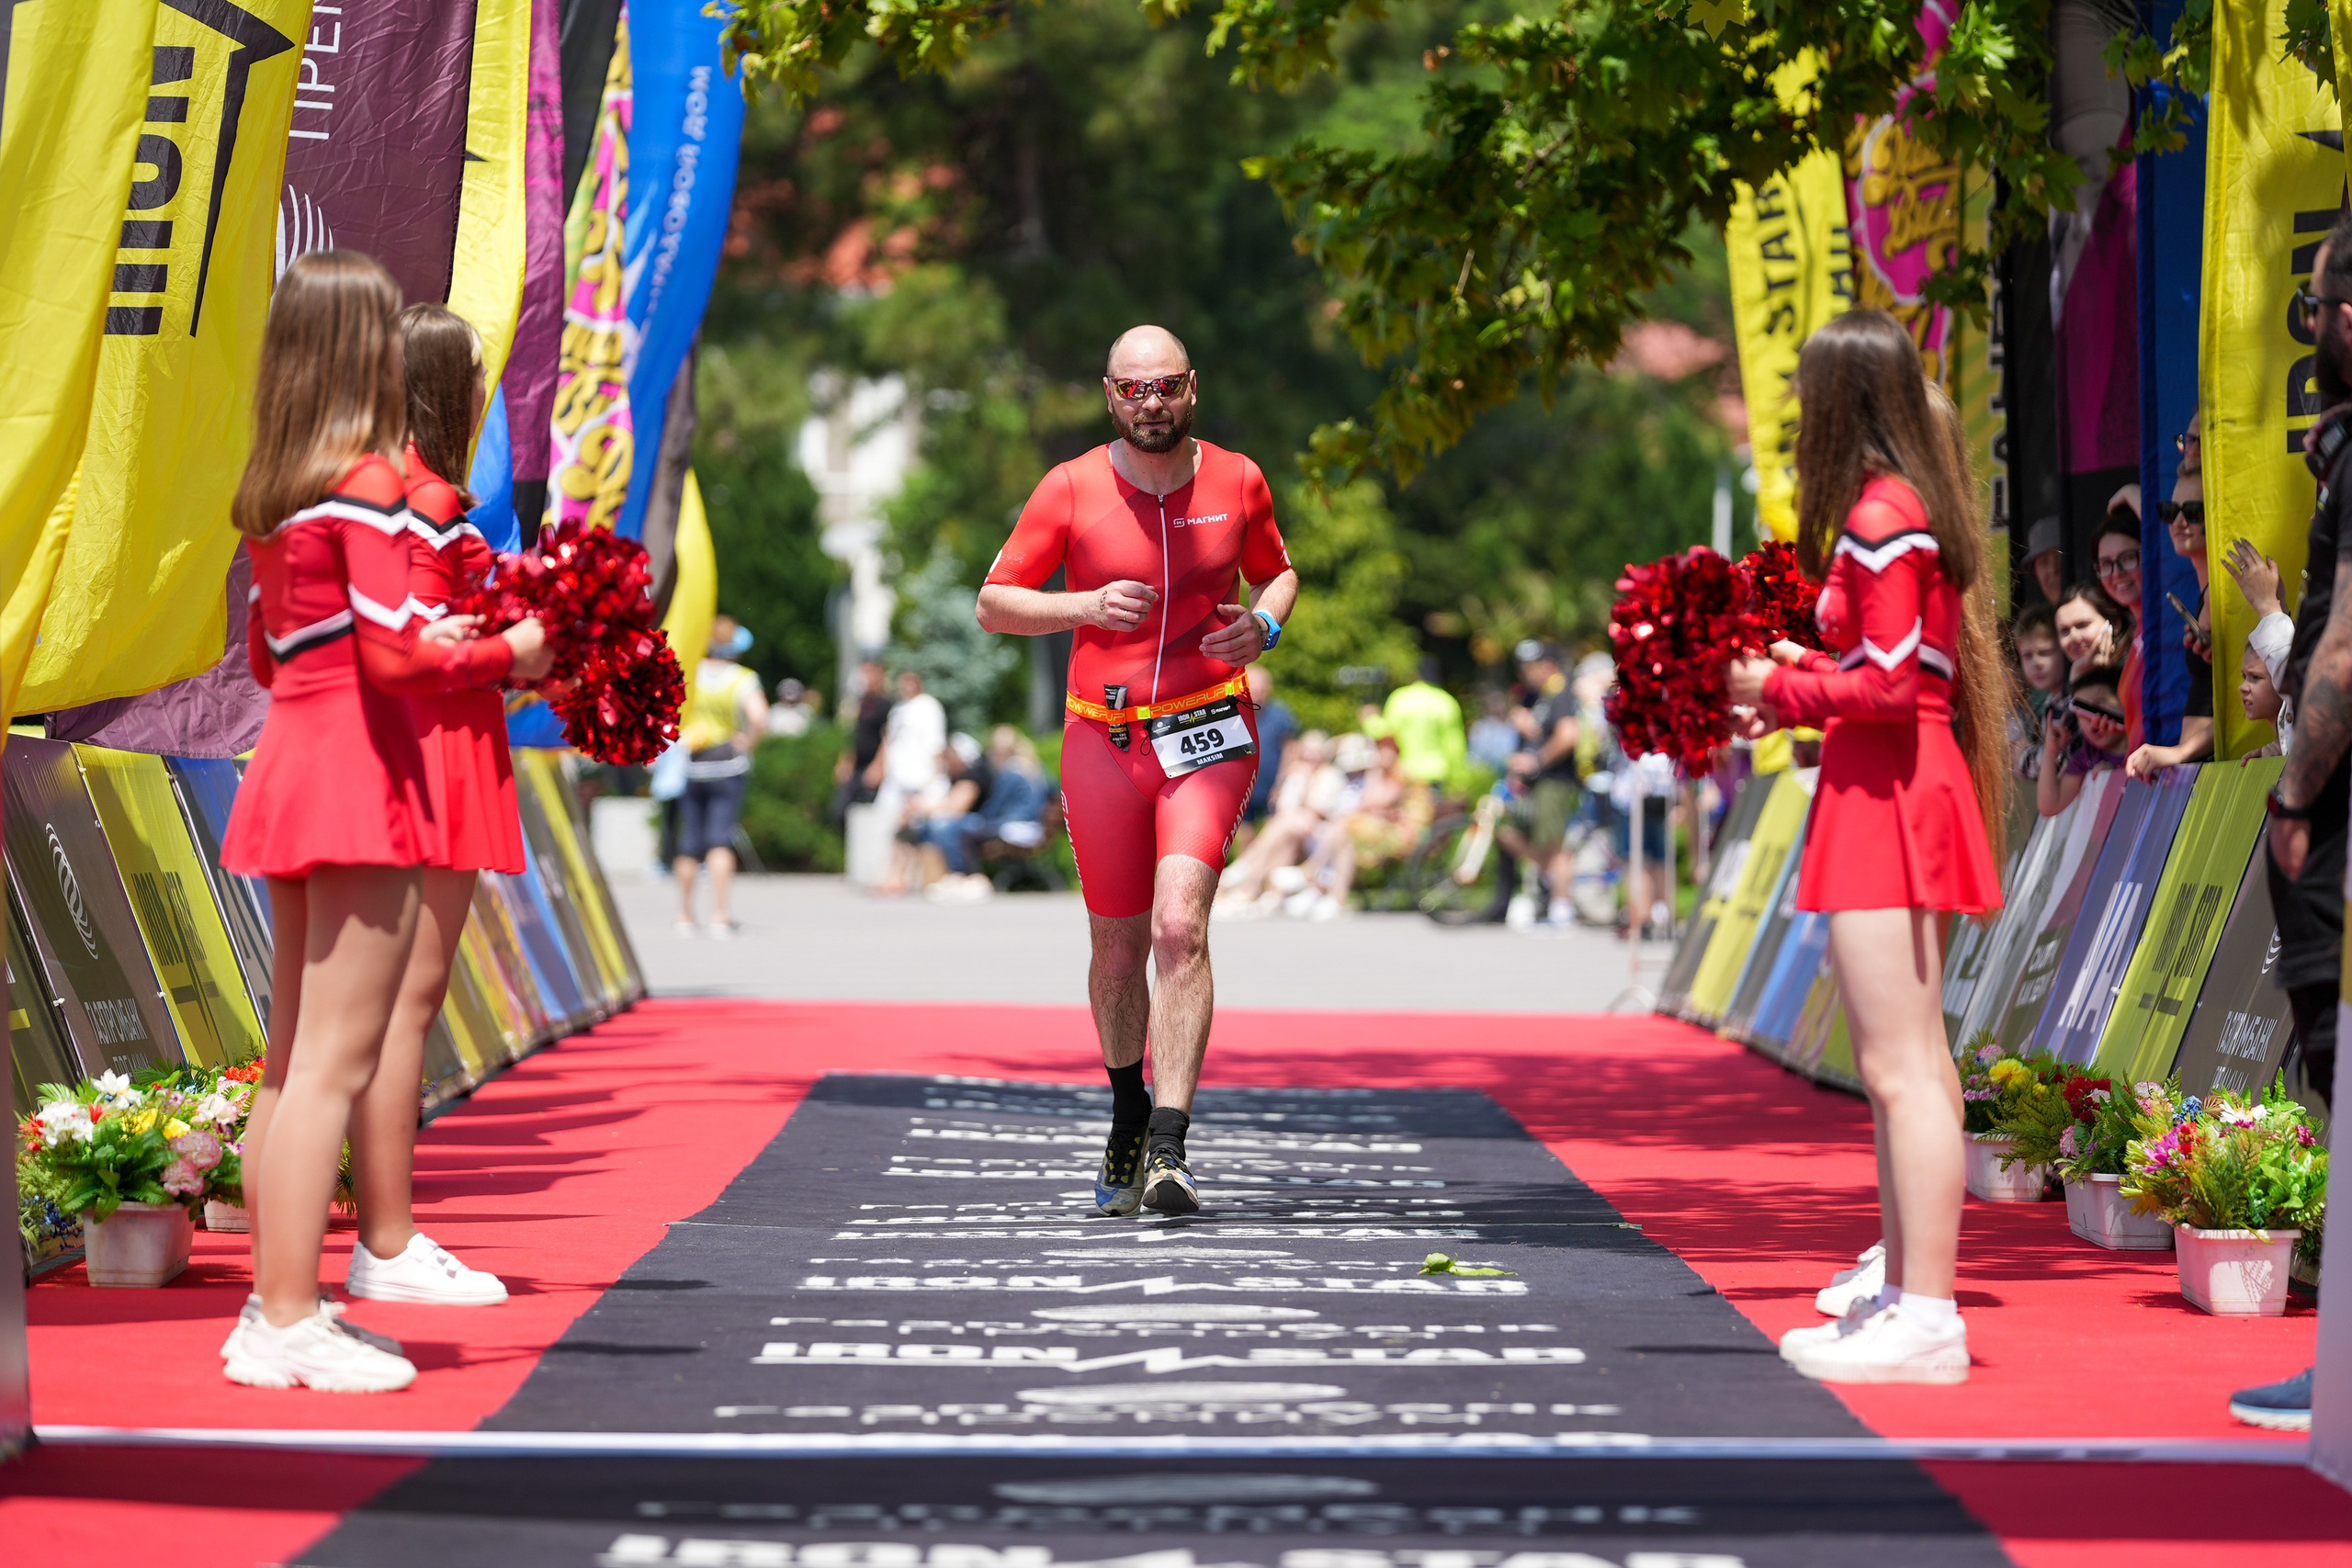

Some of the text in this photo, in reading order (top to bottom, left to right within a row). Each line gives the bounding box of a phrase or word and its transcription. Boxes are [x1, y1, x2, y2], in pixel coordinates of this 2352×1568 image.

[681, 65, 711, 141] ДОМ
[1754, 186, 1796, 338] STAR
[1187, 513, 1228, 525] МАГНИТ
[1150, 686, 1225, 716] POWERUP
[1193, 708, 1207, 717] STAR
[1180, 728, 1225, 756] 459
[1196, 752, 1225, 766] MAKSIM
[1229, 769, 1259, 838] МАГНИТ
[130, 872, 184, 966] IRON
[2180, 884, 2223, 978] STAR
[84, 997, 150, 1044] ГАЗПРОМБАНК
[803, 1274, 1530, 1292] IRON STAR
[759, 1341, 1587, 1360] IRON STAR
[608, 1533, 1053, 1567] IRON
